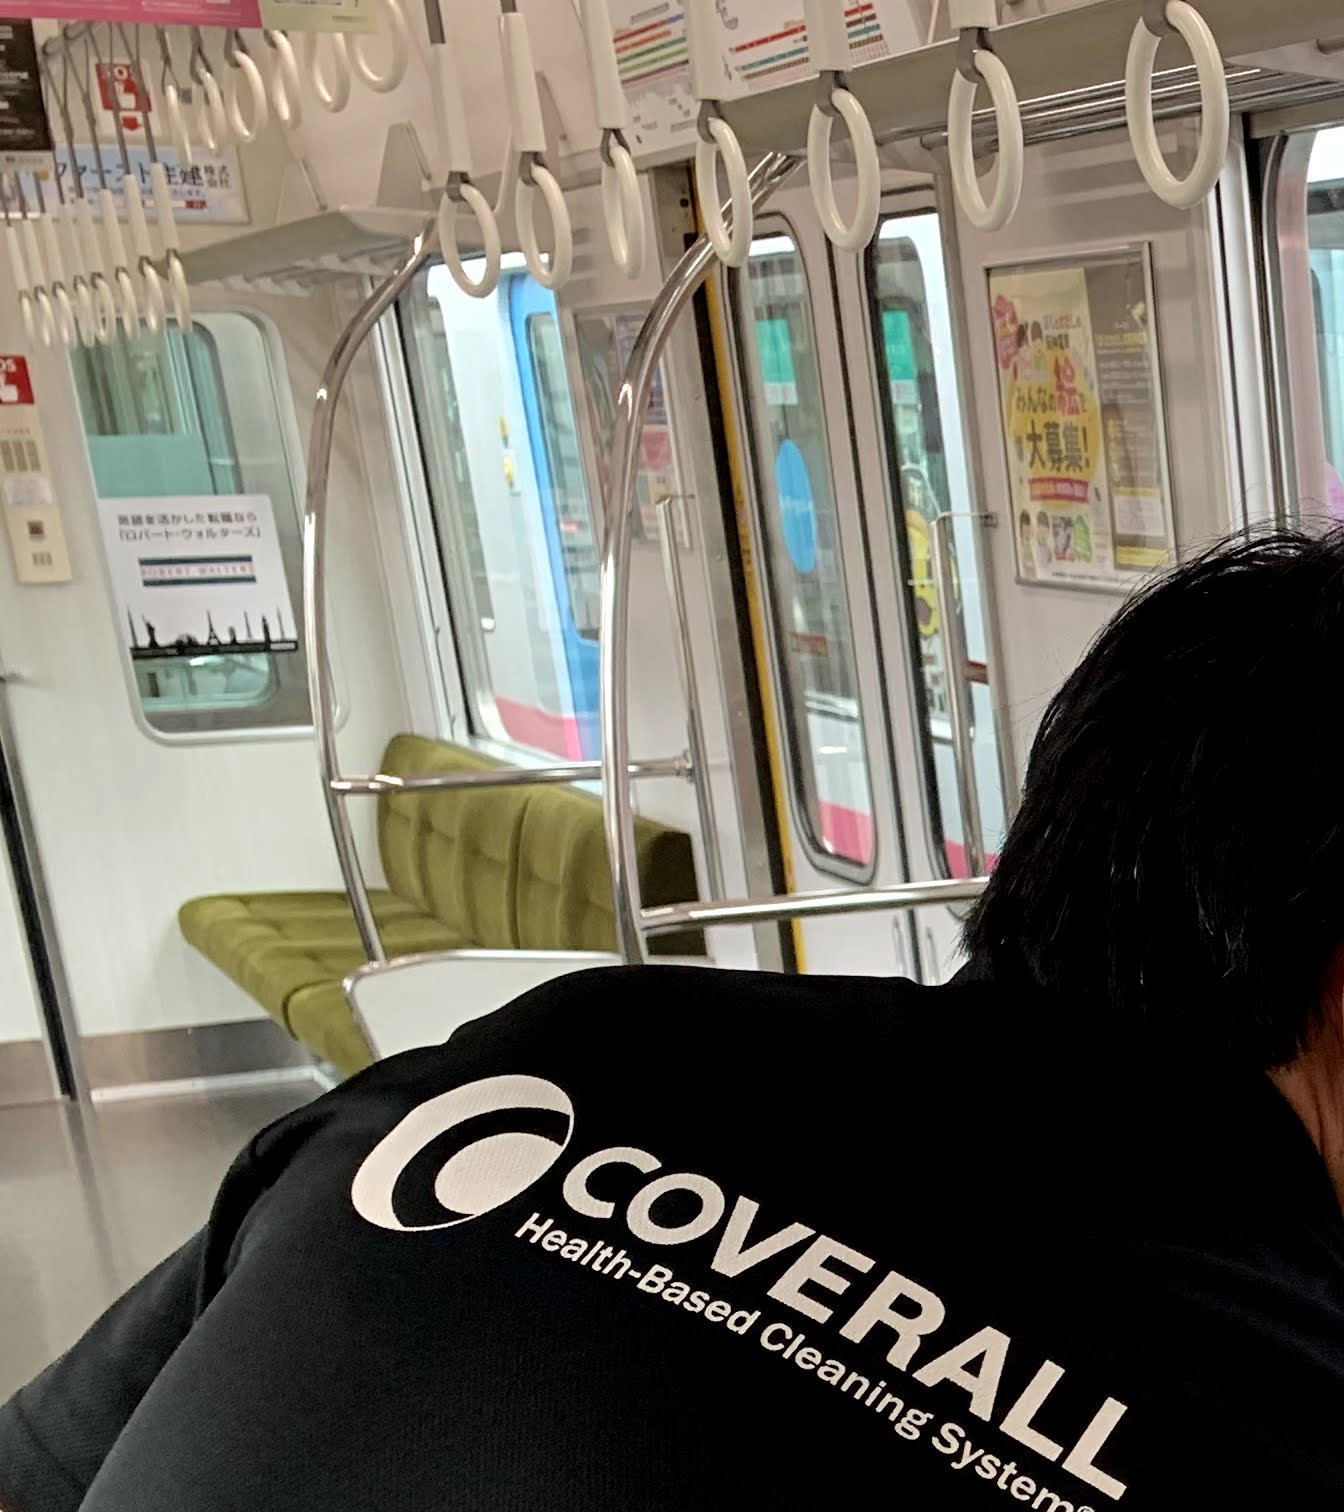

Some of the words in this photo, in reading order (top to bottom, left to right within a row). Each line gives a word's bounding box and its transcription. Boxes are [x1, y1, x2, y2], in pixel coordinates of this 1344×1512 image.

[514, 1212, 762, 1336] Health-Based
[759, 1322, 935, 1441] Cleaning
[562, 1146, 1128, 1501] COVERALL
